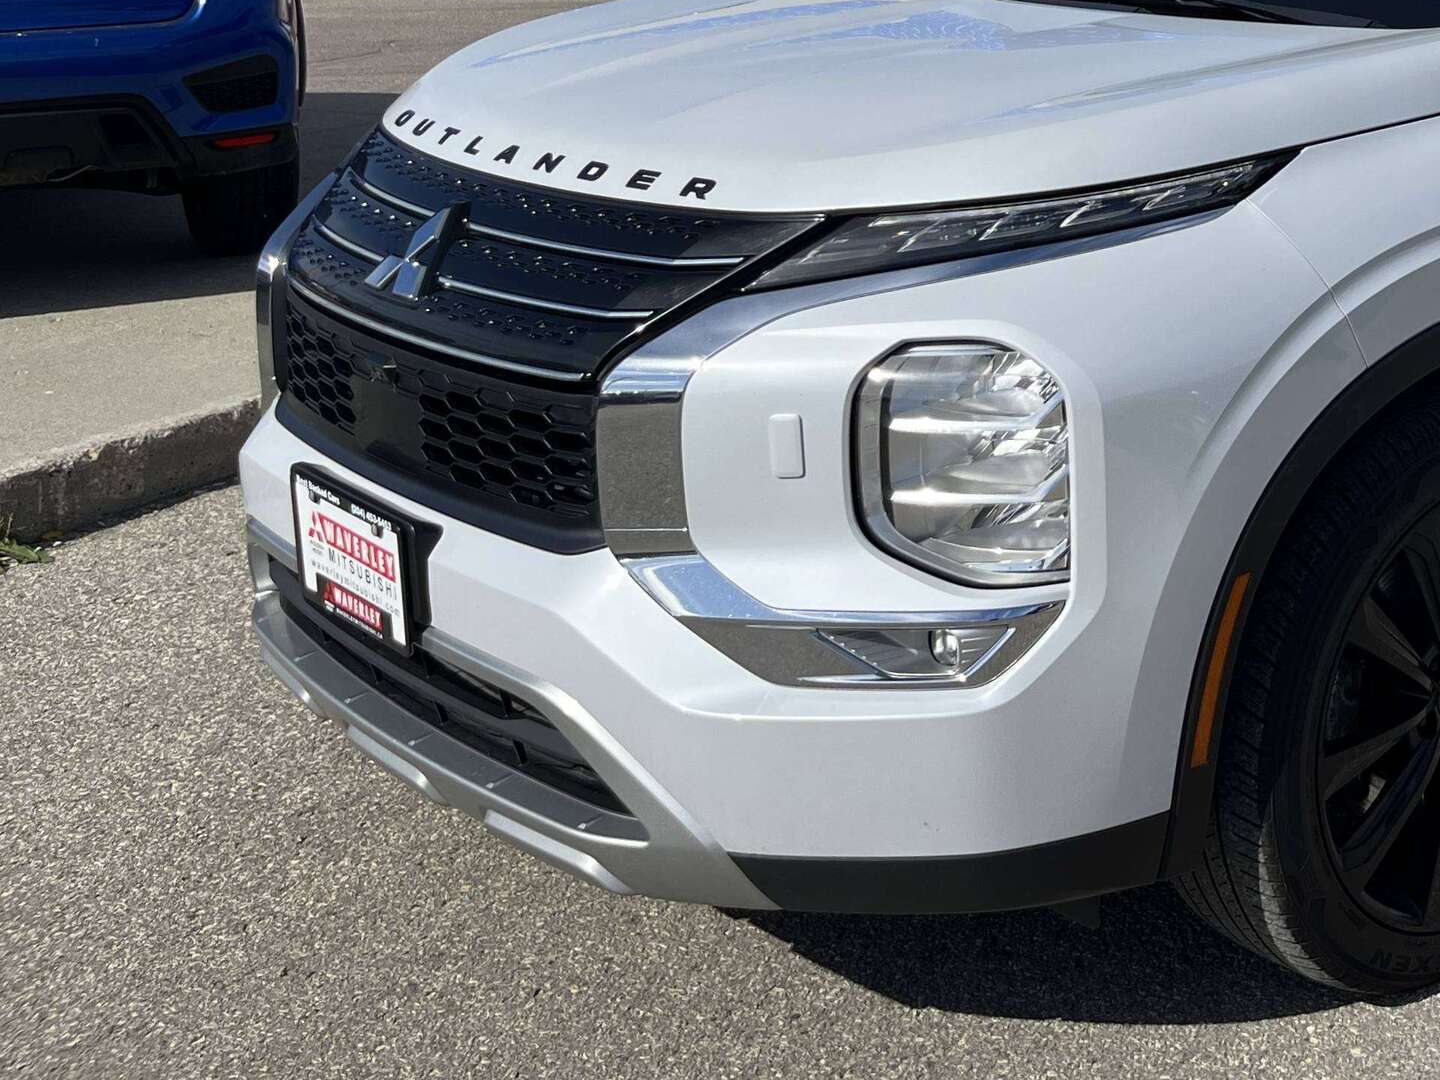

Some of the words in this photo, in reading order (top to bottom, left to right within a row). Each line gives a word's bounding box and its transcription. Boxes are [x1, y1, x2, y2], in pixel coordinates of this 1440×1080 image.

[394, 109, 718, 200] OUTLANDER
[322, 516, 394, 580] WAVERLEY
[328, 546, 397, 601] MITSUBISHI
[334, 584, 381, 630] WAVERLEY
